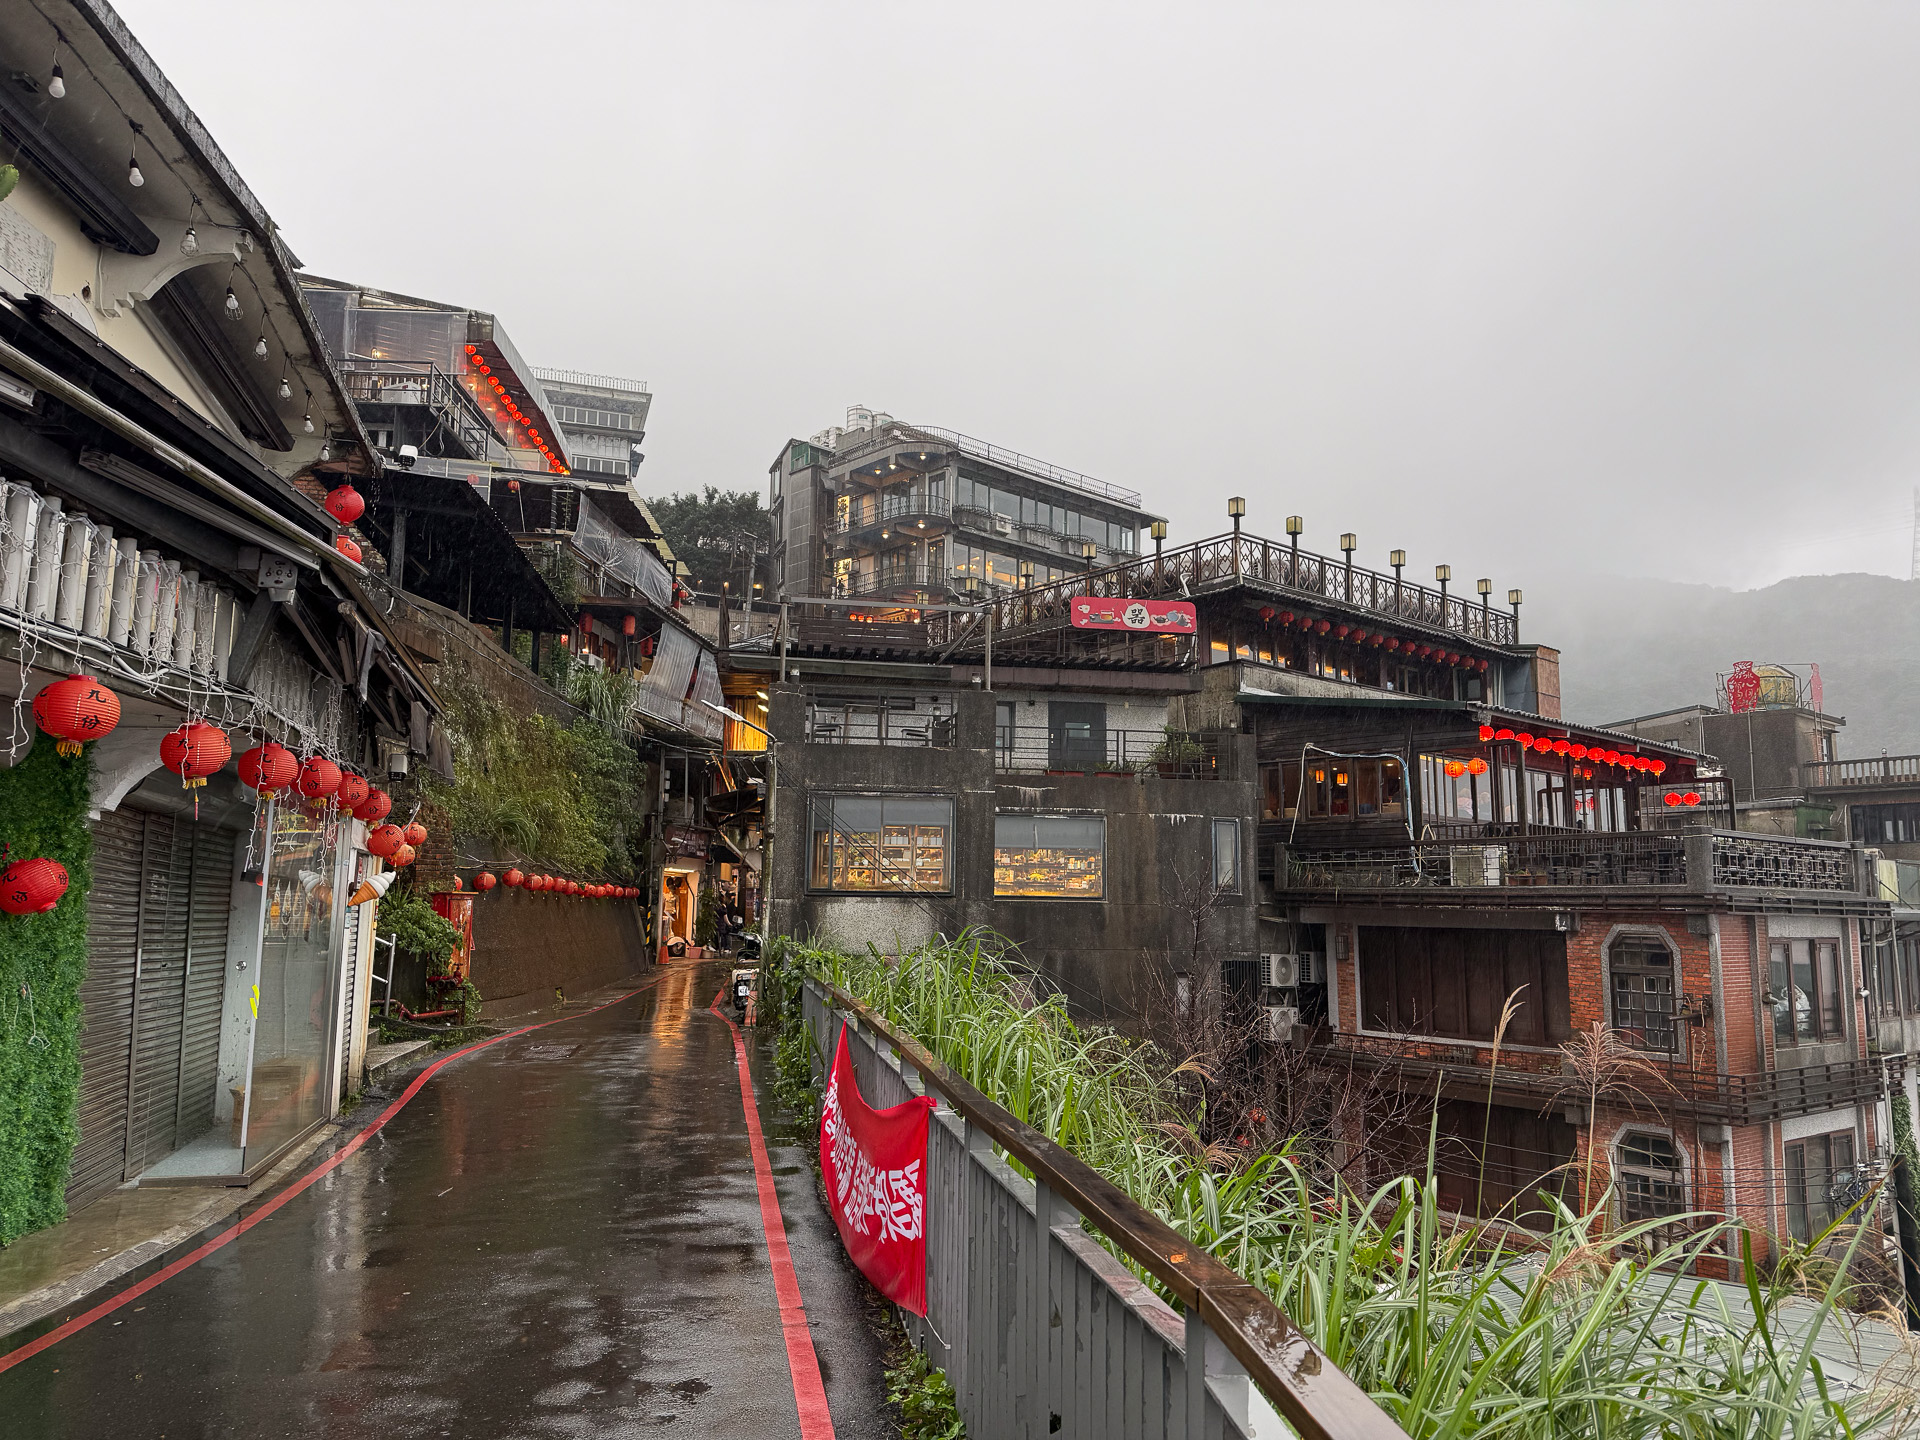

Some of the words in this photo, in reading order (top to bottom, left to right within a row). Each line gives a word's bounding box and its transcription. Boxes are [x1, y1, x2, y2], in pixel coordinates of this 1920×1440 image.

[81, 688, 107, 730] 九份
[177, 738, 194, 771] 九份
[254, 753, 272, 782] 九份
[305, 764, 319, 790] 九份
[350, 777, 362, 800] 九份
[368, 792, 379, 814] 九份
[385, 829, 400, 849] 九份
[2, 872, 28, 904] 九份
